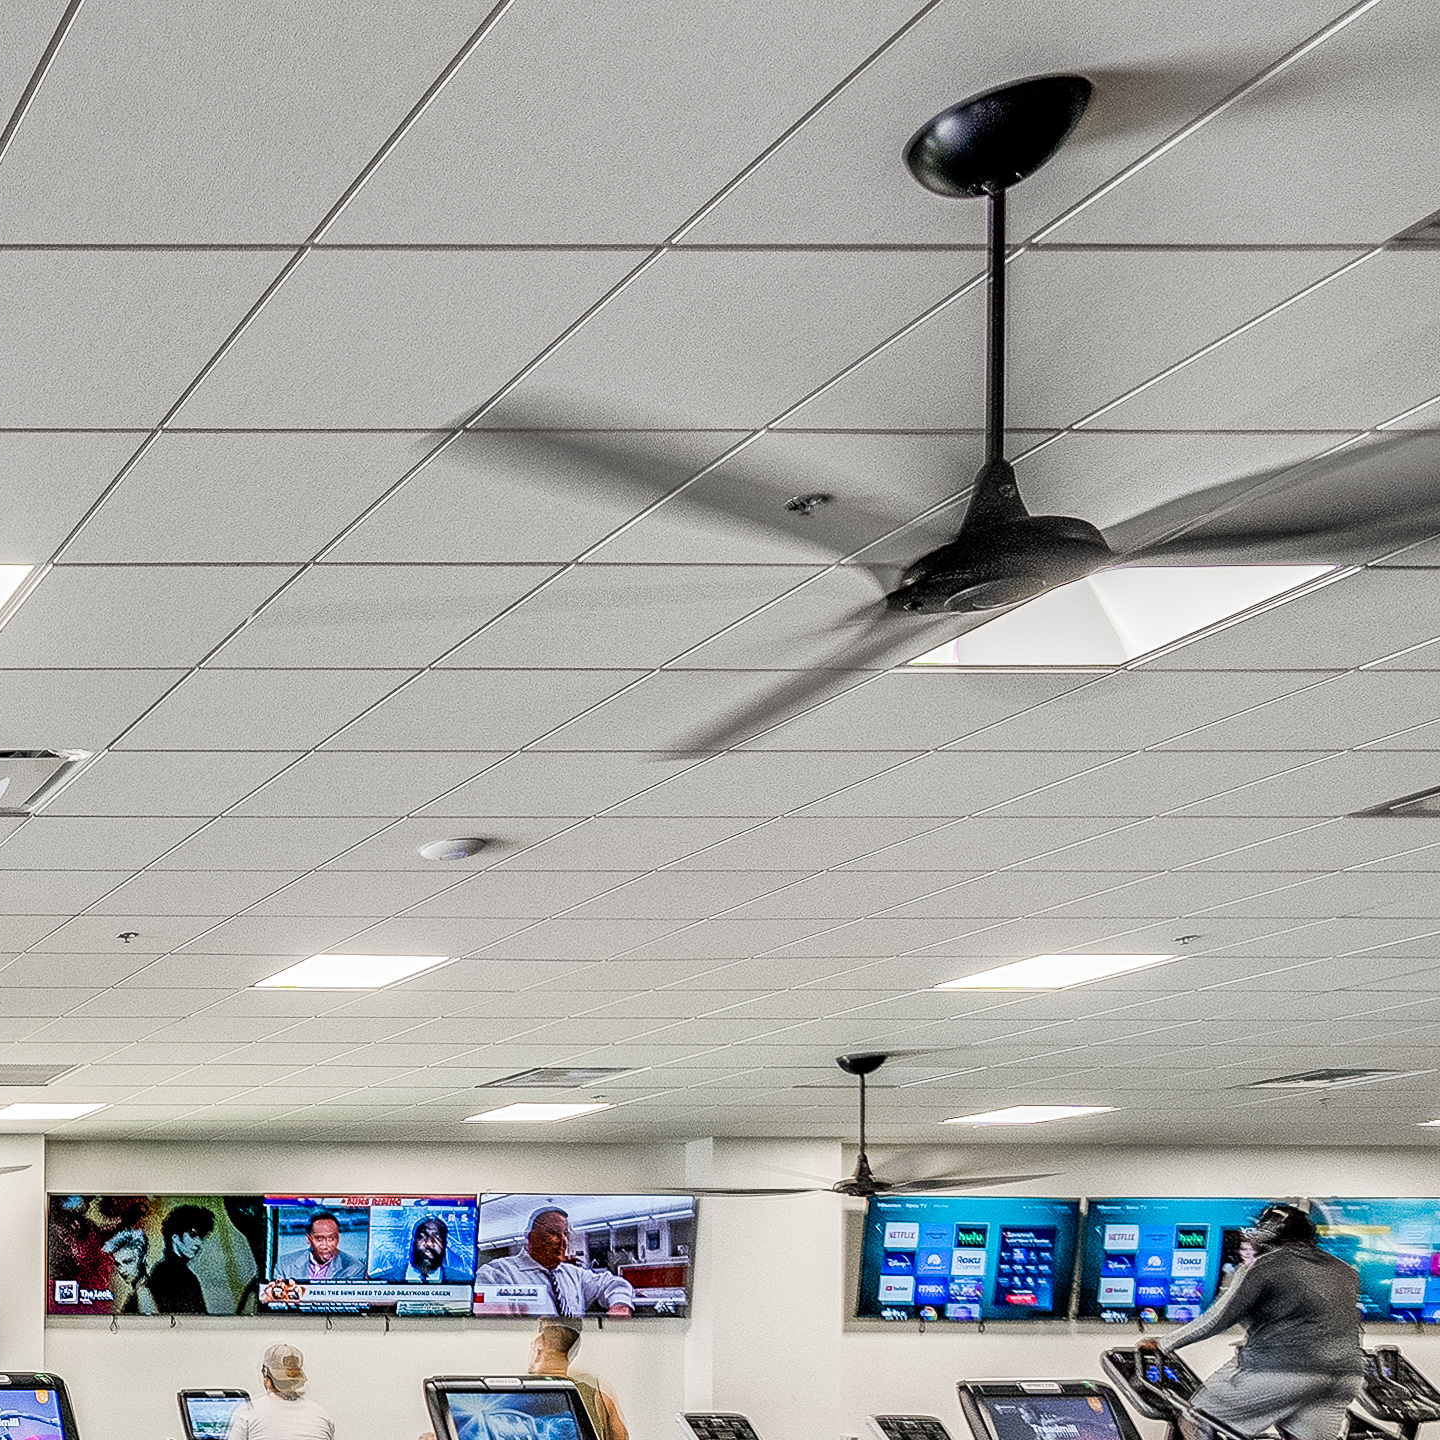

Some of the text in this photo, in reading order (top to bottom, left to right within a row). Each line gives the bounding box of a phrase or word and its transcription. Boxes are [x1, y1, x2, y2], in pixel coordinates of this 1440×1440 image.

[889, 1231, 915, 1239] NETFLIX
[959, 1231, 984, 1243] hulu
[1108, 1233, 1135, 1241] NETFLIX
[957, 1255, 982, 1264] Roku
[918, 1285, 944, 1293] max
[1138, 1286, 1165, 1295] max
[1395, 1286, 1422, 1295] NETFLIX
[80, 1289, 114, 1300] The Look
[1031, 1424, 1080, 1433] Treadmill
